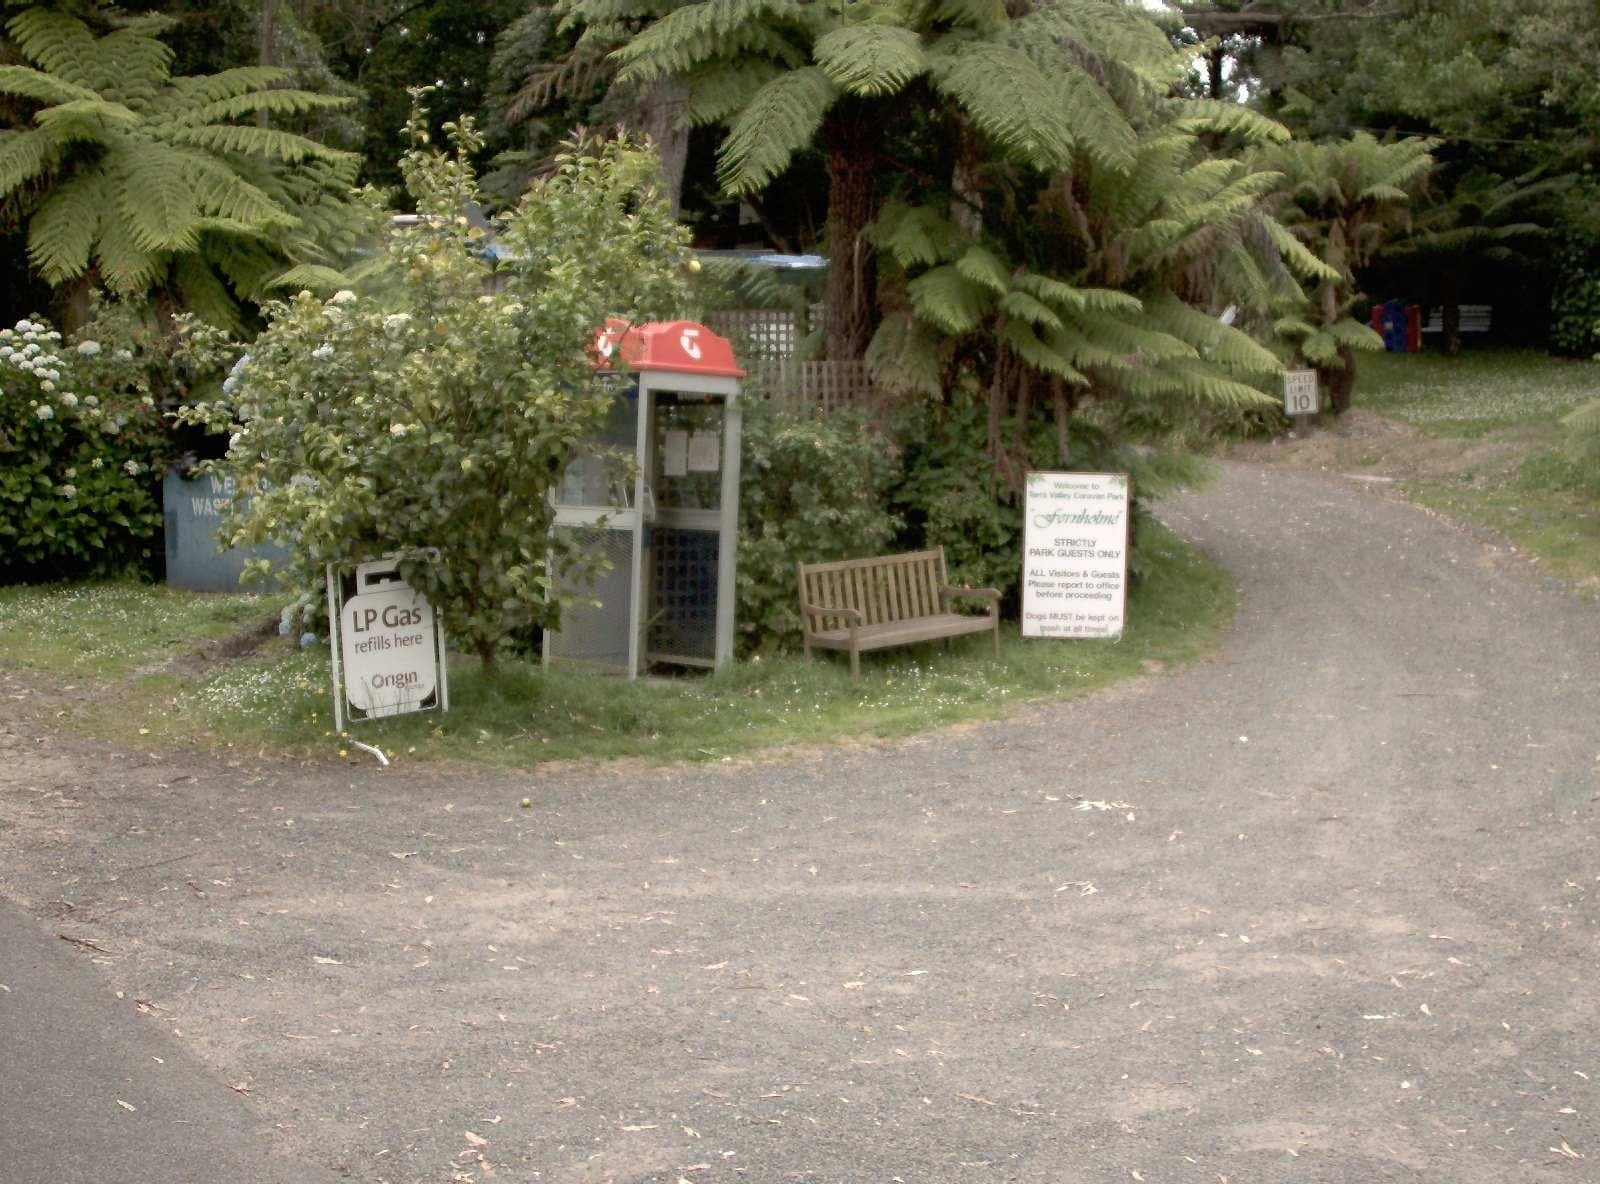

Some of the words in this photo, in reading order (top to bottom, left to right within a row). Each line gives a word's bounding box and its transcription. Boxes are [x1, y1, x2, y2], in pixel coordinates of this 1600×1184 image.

[1293, 394, 1311, 410] 10
[1054, 482, 1089, 490] Welcome
[1092, 482, 1100, 490] to
[1050, 492, 1071, 501] Valley
[1073, 492, 1105, 500] Caravan
[1107, 492, 1124, 500] Park
[1054, 538, 1097, 547] STRICTLY
[1030, 548, 1055, 557] PARK
[1057, 549, 1095, 558] GUESTS
[1097, 550, 1121, 559] ONLY
[1029, 569, 1046, 577] ALL
[1049, 569, 1080, 578] Visitors
[1082, 570, 1088, 578] &
[1091, 570, 1120, 579] Guests
[1028, 579, 1055, 588] Please
[1058, 580, 1083, 590] report
[1085, 581, 1093, 590] to
[1096, 581, 1120, 590] office
[1036, 590, 1064, 598] before
[1065, 591, 1112, 602] proceeding
[352, 609, 377, 633] LP
[382, 605, 422, 629] Gas
[1025, 612, 1047, 621] Dogs
[1049, 612, 1073, 621] MUST
[1075, 613, 1085, 621] be
[1088, 613, 1105, 623] kept
[1063, 624, 1071, 633] at
[355, 636, 391, 654] refills
[394, 632, 423, 649] here
[371, 671, 418, 689] Origin
